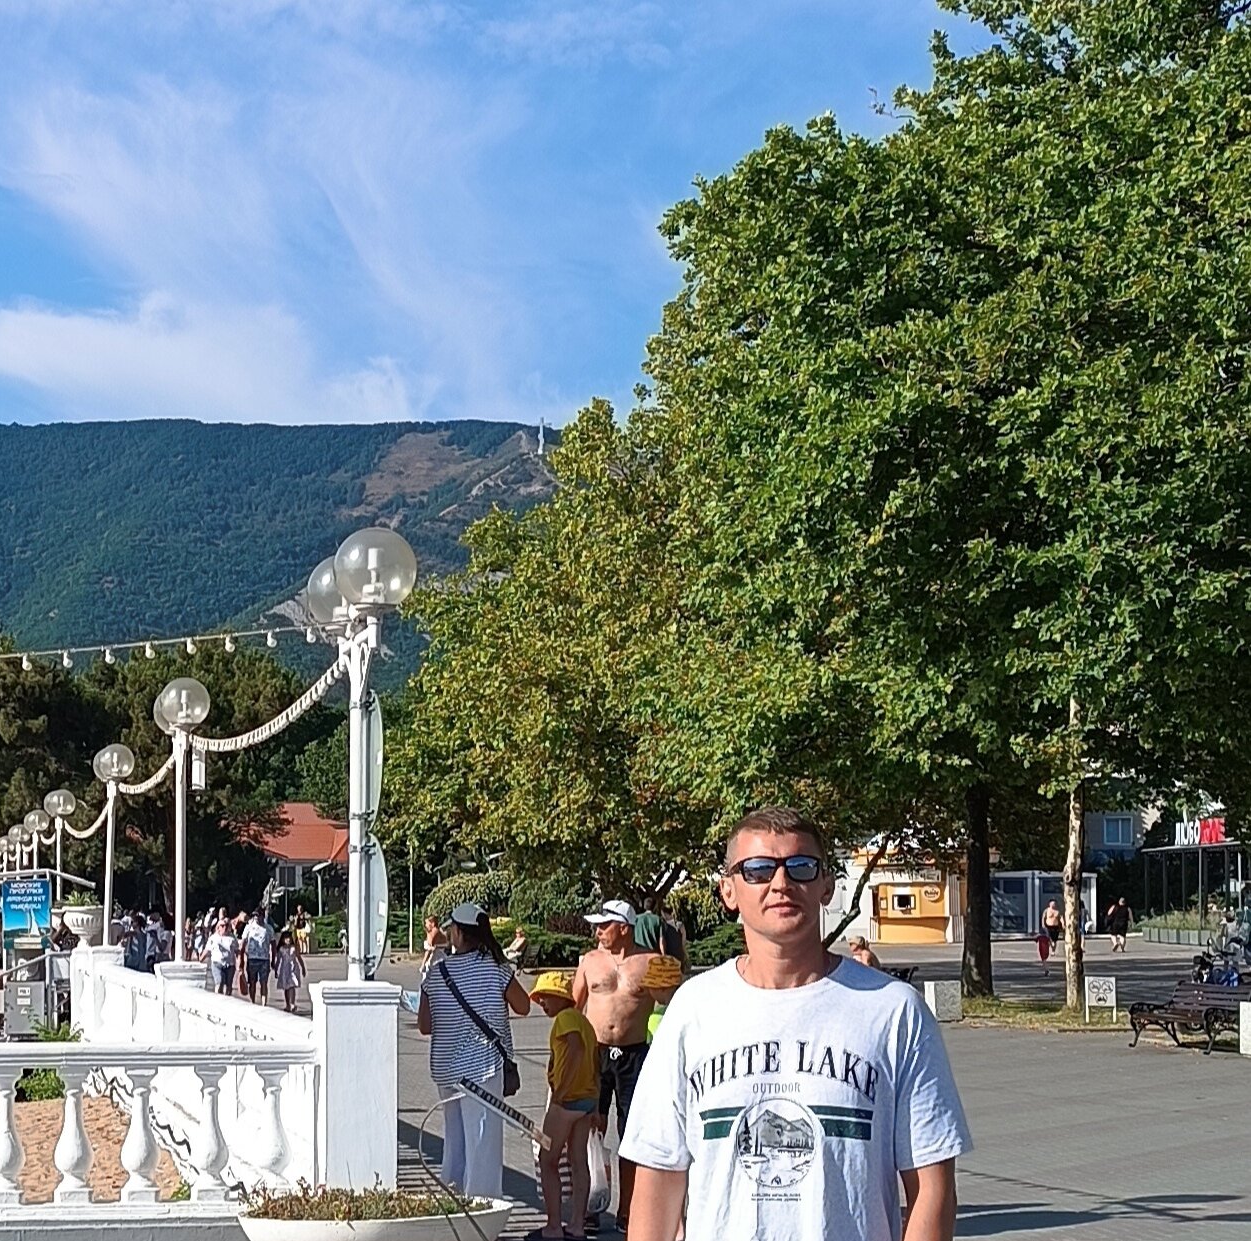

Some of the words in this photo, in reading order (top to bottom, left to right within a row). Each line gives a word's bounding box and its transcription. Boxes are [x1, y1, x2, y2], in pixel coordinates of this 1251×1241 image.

[689, 1039, 781, 1103] WHITE
[796, 1039, 879, 1104] LAKE
[752, 1082, 801, 1095] OUTDOOR
